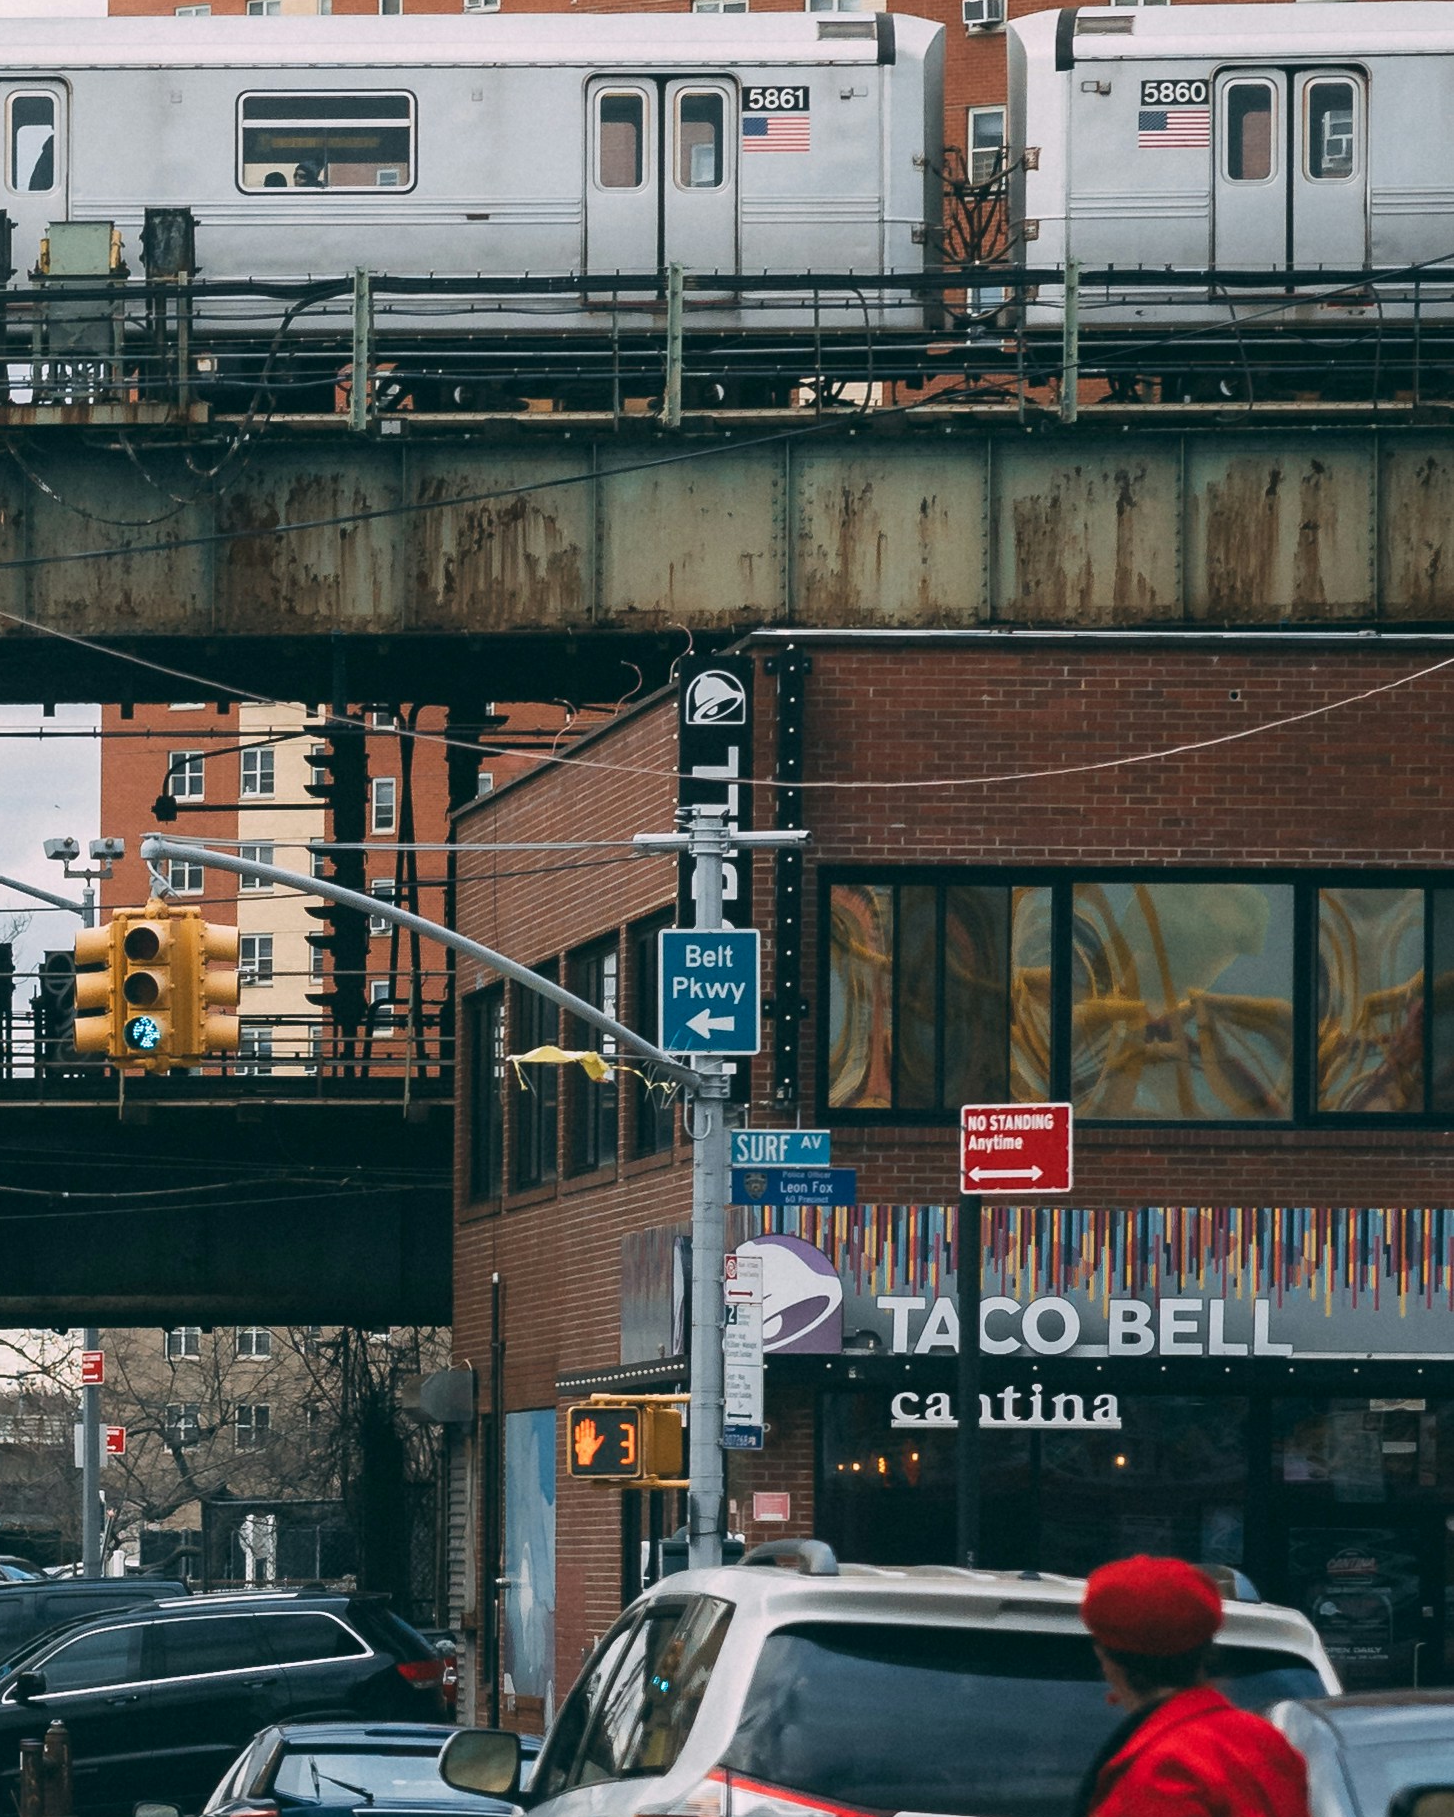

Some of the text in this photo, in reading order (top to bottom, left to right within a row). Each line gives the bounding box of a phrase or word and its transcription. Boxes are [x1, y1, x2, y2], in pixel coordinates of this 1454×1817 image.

[749, 88, 804, 109] 5861
[1144, 82, 1206, 103] 5860
[685, 944, 734, 968] Belt
[672, 976, 746, 1005] Pkwy
[968, 1113, 1055, 1132] NO STANDING
[737, 1134, 823, 1162] SURF AV
[968, 1134, 1024, 1154] Anytime
[780, 1181, 834, 1194] Leon Fox
[877, 1296, 1294, 1357] TACO BELL
[619, 1423, 635, 1464] 3
